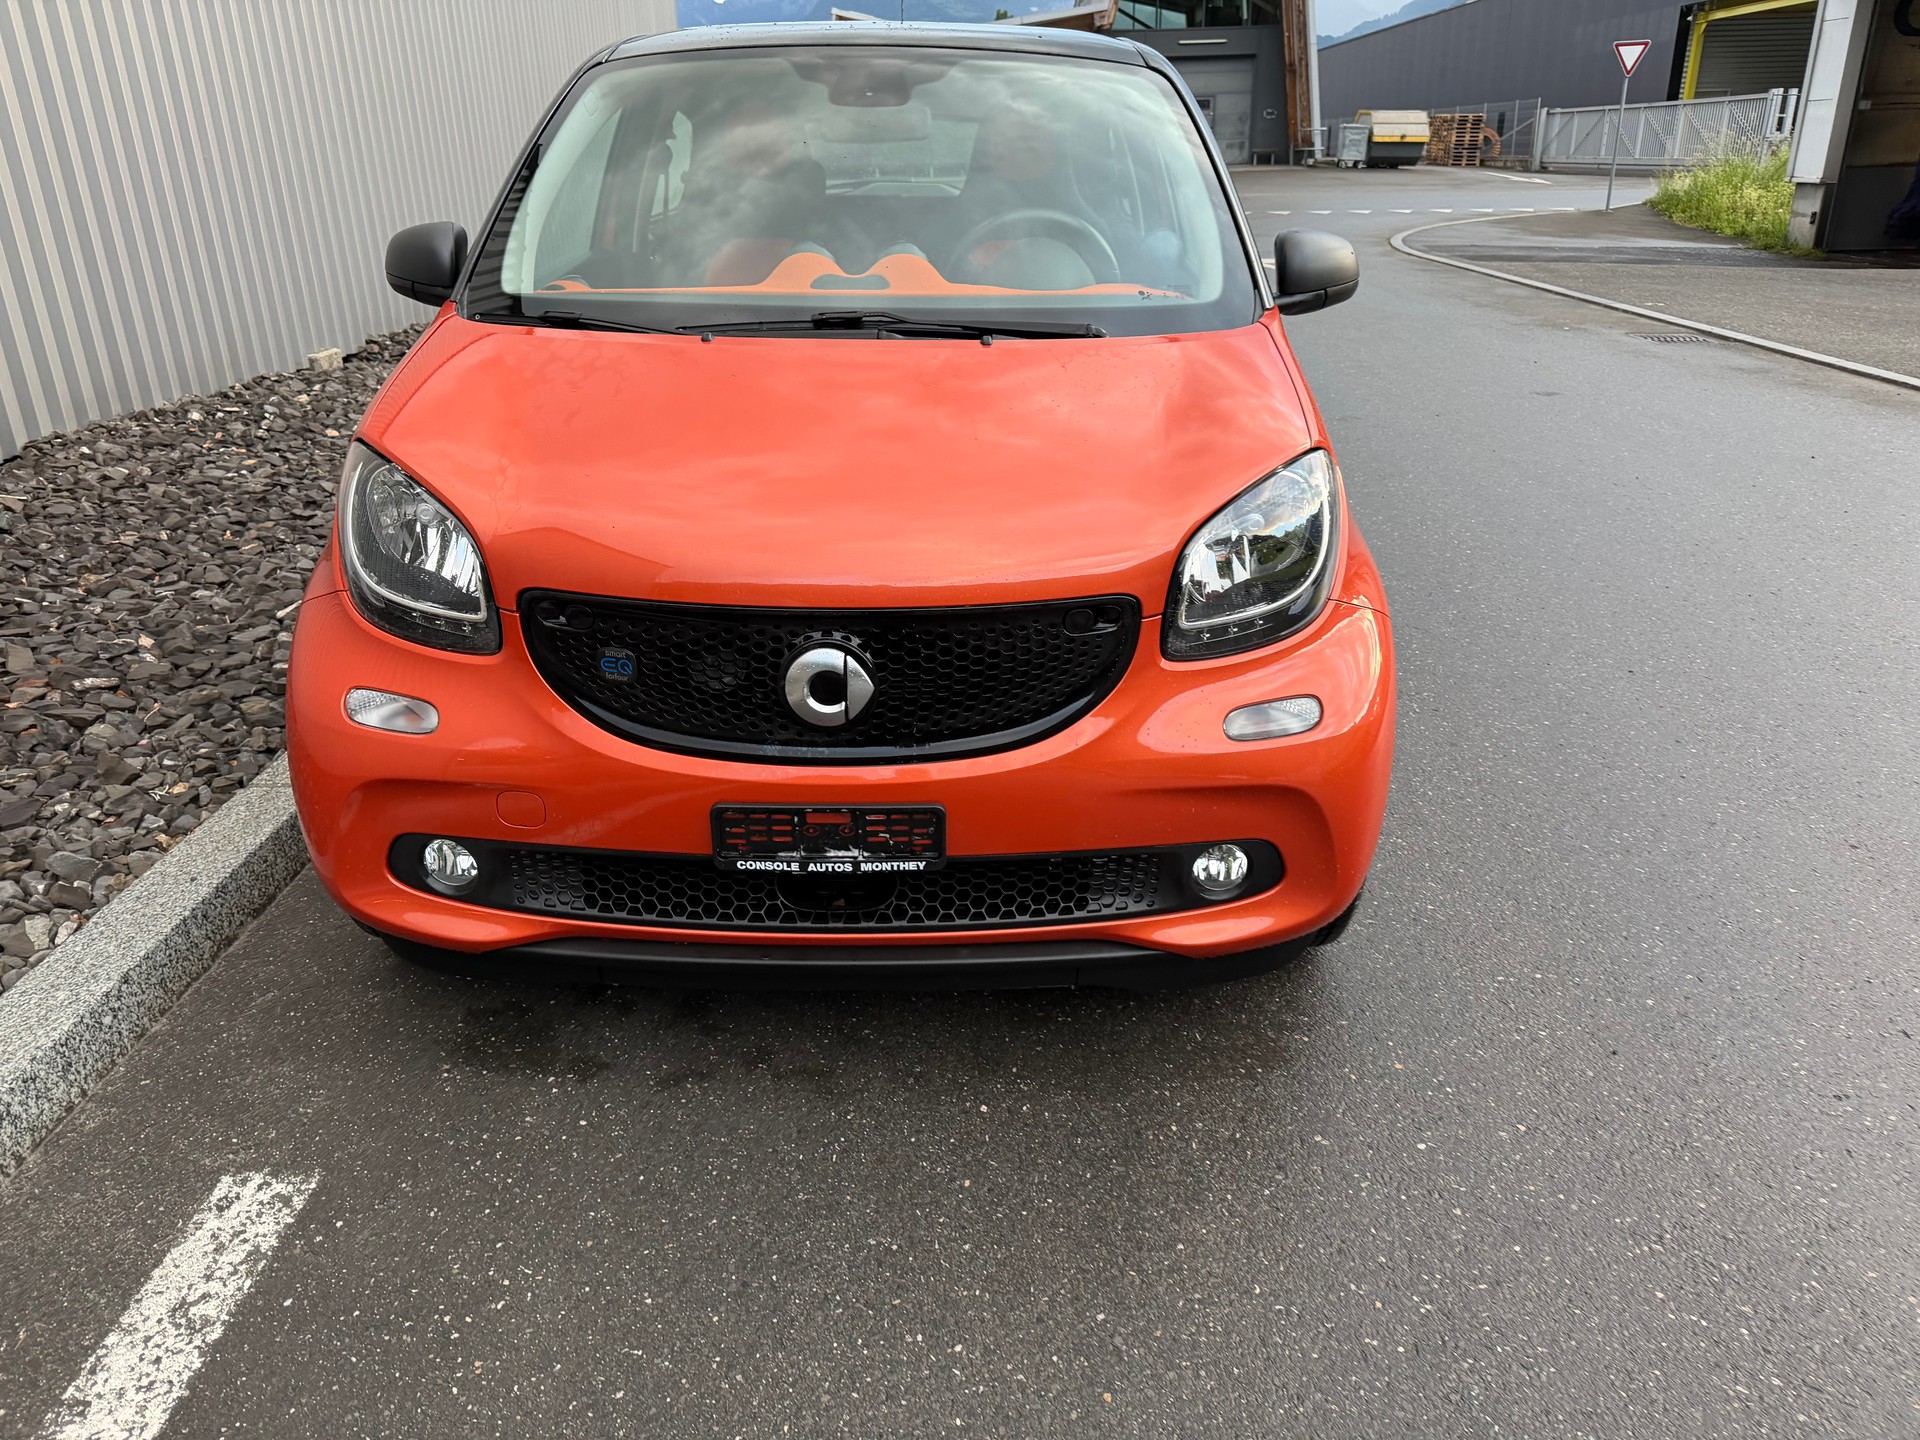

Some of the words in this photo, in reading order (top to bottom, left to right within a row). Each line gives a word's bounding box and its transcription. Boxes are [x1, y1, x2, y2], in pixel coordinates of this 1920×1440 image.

[605, 650, 626, 658] smart
[600, 657, 633, 675] EQ
[736, 860, 800, 871] CONSOLE
[807, 862, 853, 872] AUTOS
[860, 861, 926, 871] MONTHEY
